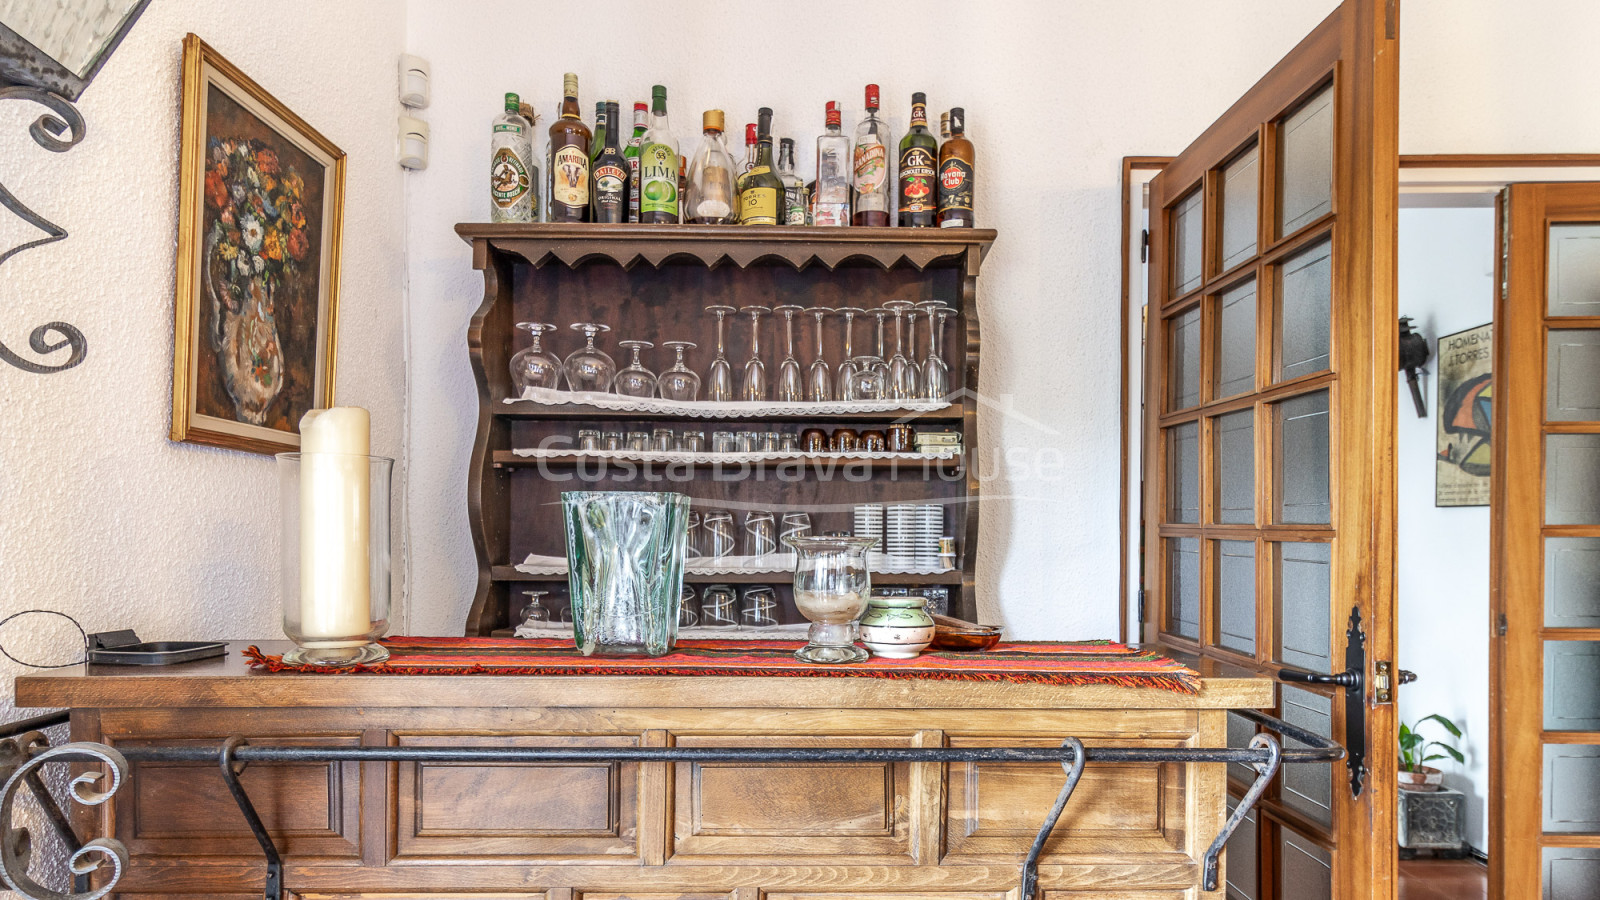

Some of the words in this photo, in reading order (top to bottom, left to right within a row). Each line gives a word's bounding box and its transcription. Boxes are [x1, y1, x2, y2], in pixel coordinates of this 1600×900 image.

[558, 154, 588, 171] AMARULA
[907, 154, 925, 167] GK
[595, 168, 624, 179] BAILEYS
[644, 165, 677, 183] LIMA
[941, 171, 966, 181] Havana
[944, 176, 960, 187] Club
[748, 198, 758, 206] 10
[1448, 328, 1493, 351] HOMENA
